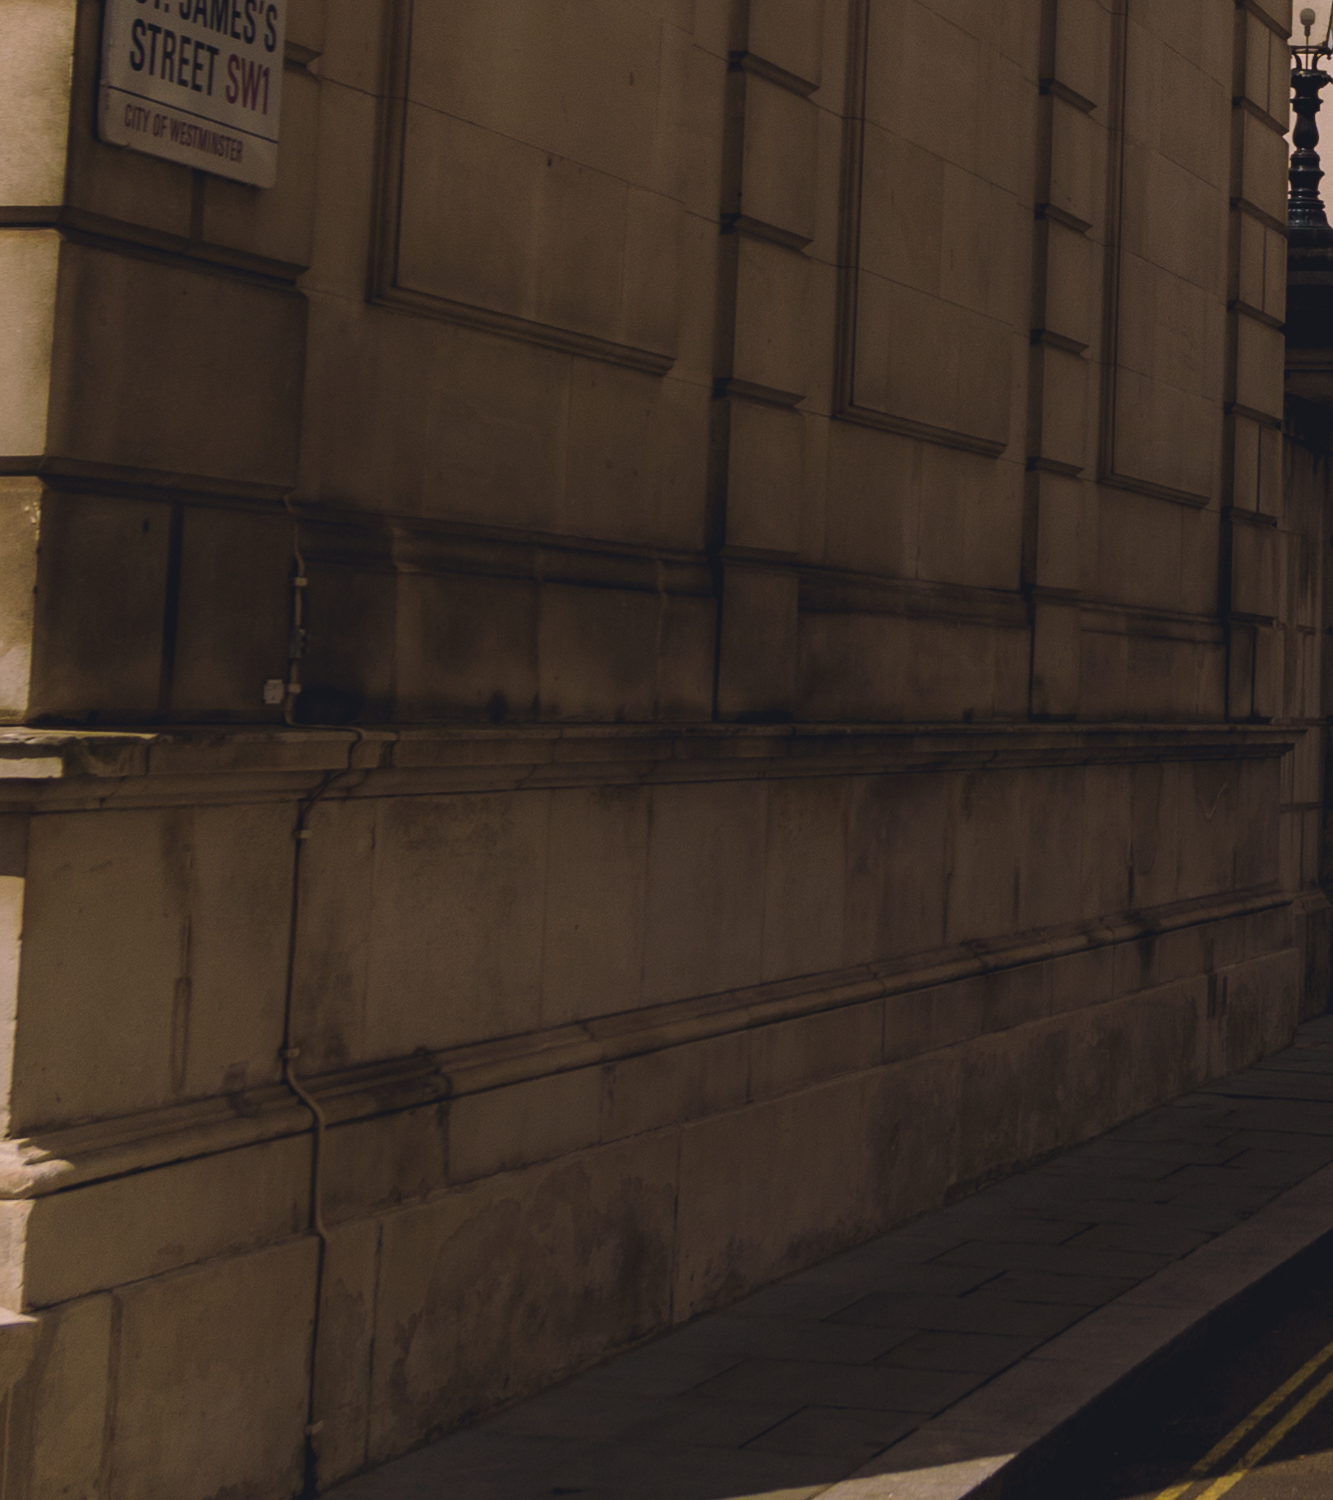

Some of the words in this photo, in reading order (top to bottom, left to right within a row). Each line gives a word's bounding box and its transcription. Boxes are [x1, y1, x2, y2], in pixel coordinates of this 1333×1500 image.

[129, 18, 220, 97] STREET
[225, 53, 270, 116] SW1
[124, 103, 151, 133] CITY
[152, 112, 169, 137] OF
[169, 116, 244, 164] WESTMINSTER
